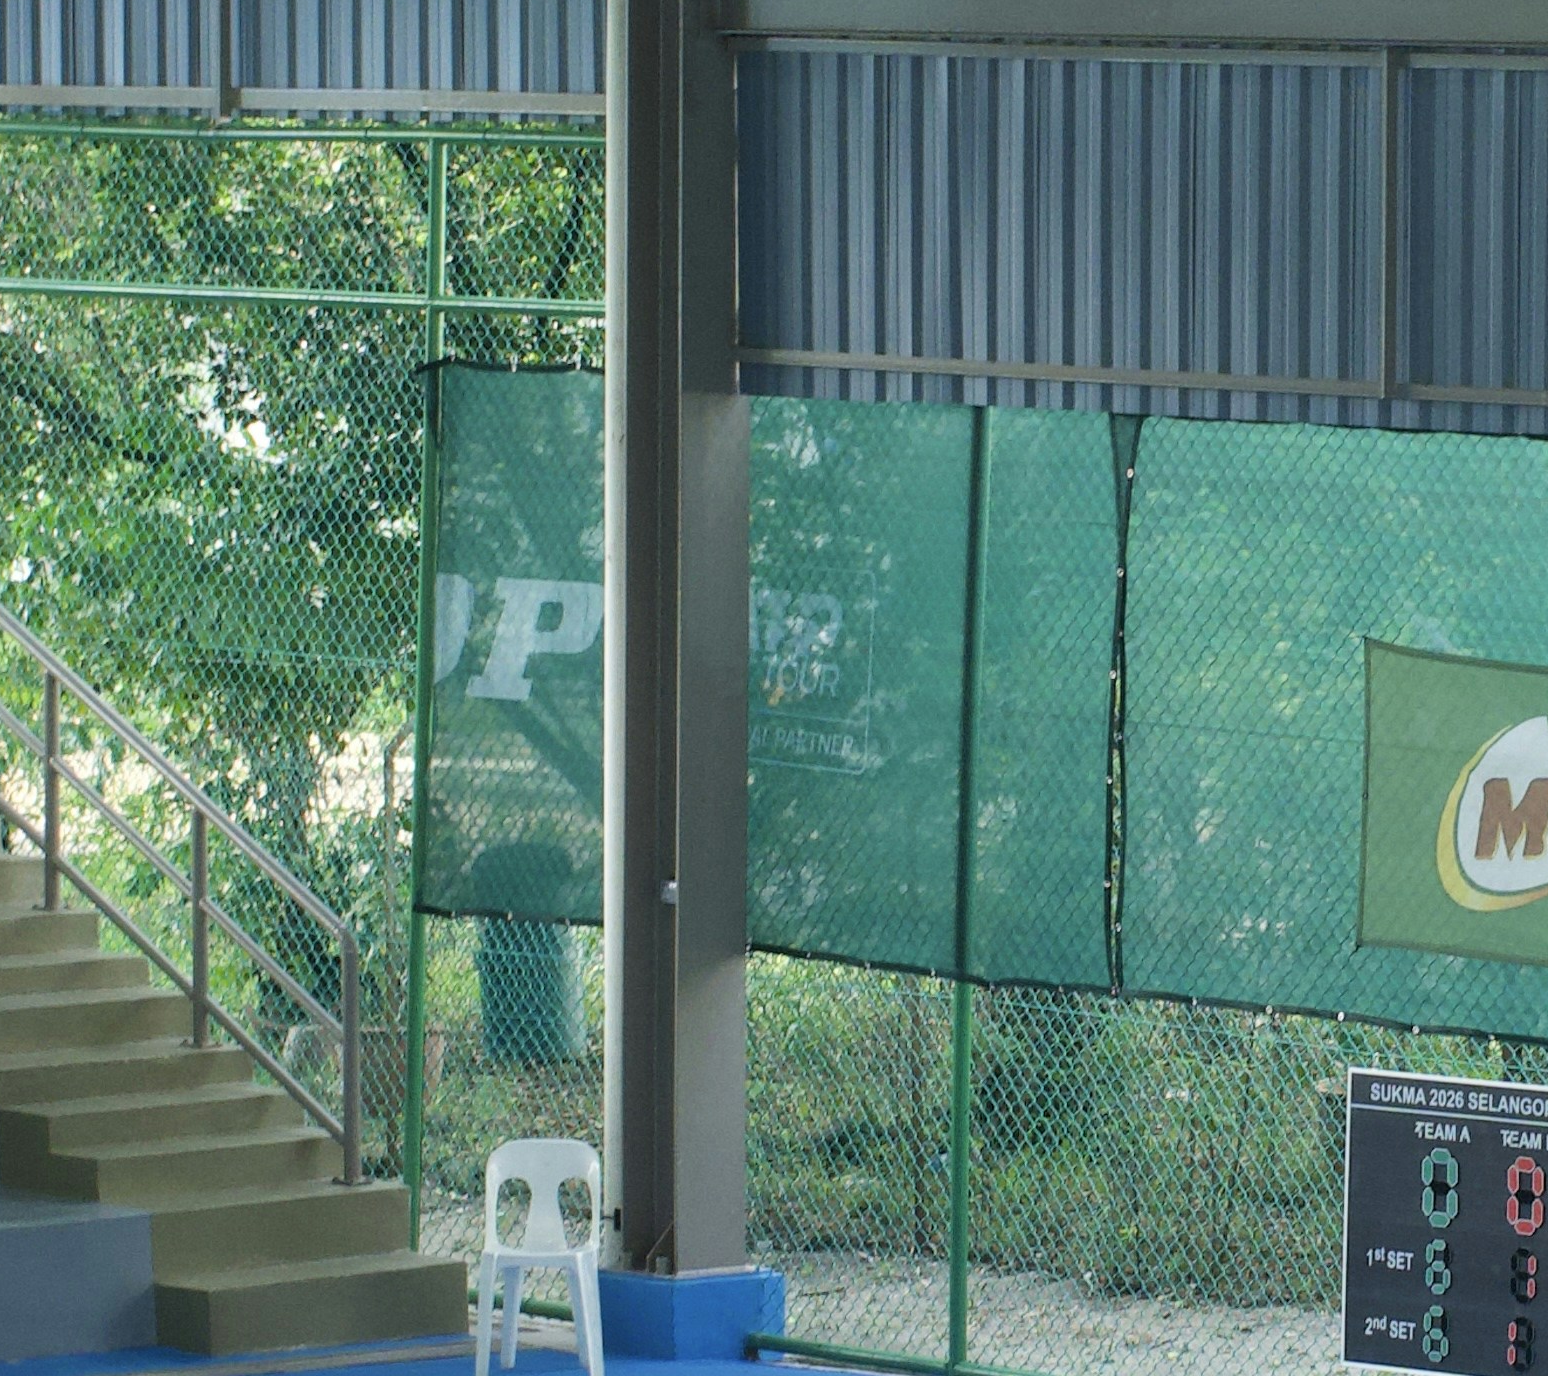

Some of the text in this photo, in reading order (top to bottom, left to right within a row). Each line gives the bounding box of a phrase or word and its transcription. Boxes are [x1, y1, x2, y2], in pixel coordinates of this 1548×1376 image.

[775, 726, 854, 757] PARTNER
[1370, 1083, 1426, 1106] SUKMA
[1429, 1090, 1465, 1109] 2026
[1415, 1121, 1471, 1144] TEAM A
[1501, 1129, 1542, 1151] TEAM
[1421, 1148, 1459, 1228] 0
[1506, 1156, 1545, 1236] 0
[1388, 1250, 1414, 1271] SET
[1425, 1238, 1451, 1295] 6
[1389, 1321, 1416, 1341] SET
[1422, 1305, 1449, 1363] 6
